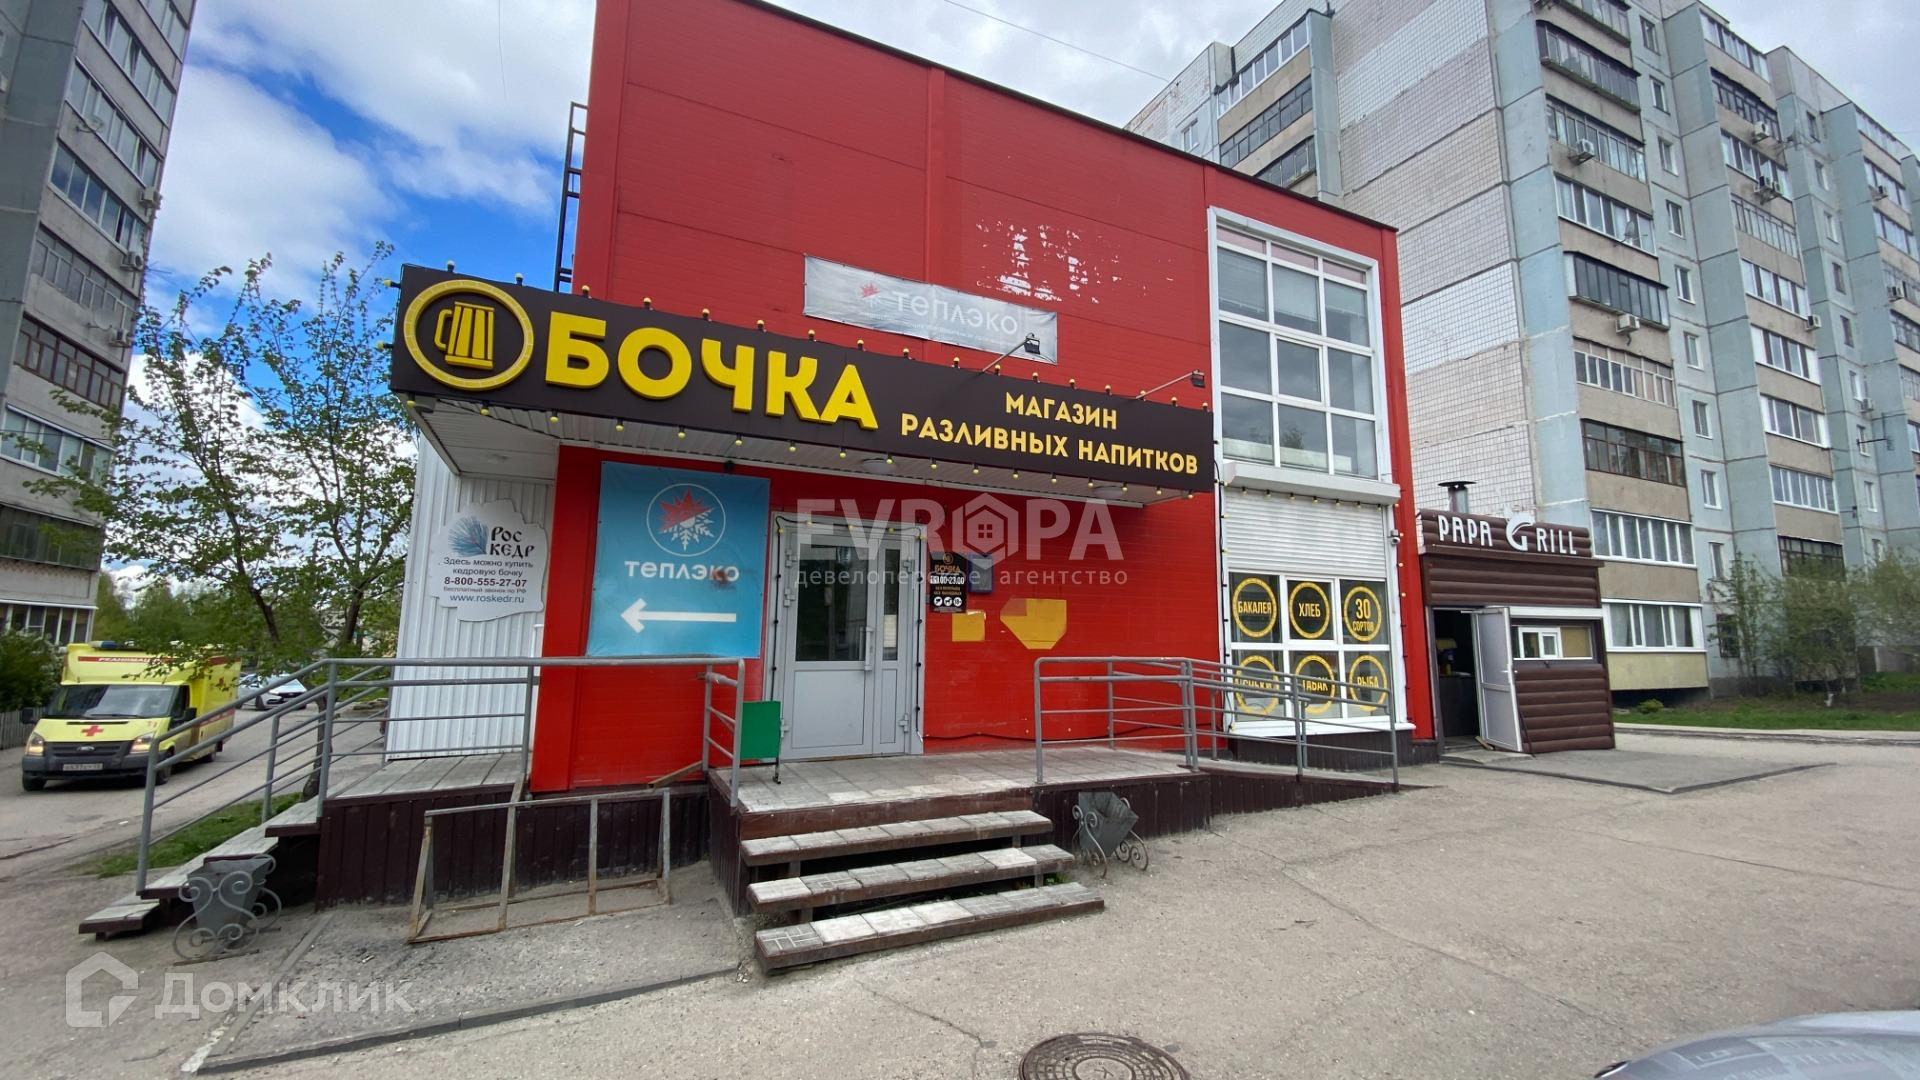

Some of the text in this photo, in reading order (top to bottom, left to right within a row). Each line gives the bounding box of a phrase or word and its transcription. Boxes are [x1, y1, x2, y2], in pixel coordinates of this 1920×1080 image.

[545, 310, 879, 430] БОЧКА
[1005, 391, 1117, 431] МАГАЗИН
[901, 412, 1199, 476] РАЗЛИВНЫХ НАПИТКОВ
[1437, 506, 1577, 555] PAPA GRILL
[444, 556, 534, 569] Здесь можно купить
[453, 568, 524, 578] кедровую бочку
[444, 577, 527, 587] 8-800-555-27-07
[450, 594, 525, 604] www.roskedr.ru
[1238, 601, 1272, 615] БАКАЛЕЯ
[1298, 602, 1321, 618] ХЛЕБ
[1355, 598, 1371, 620] 30
[1352, 620, 1375, 633] СОРТОВ
